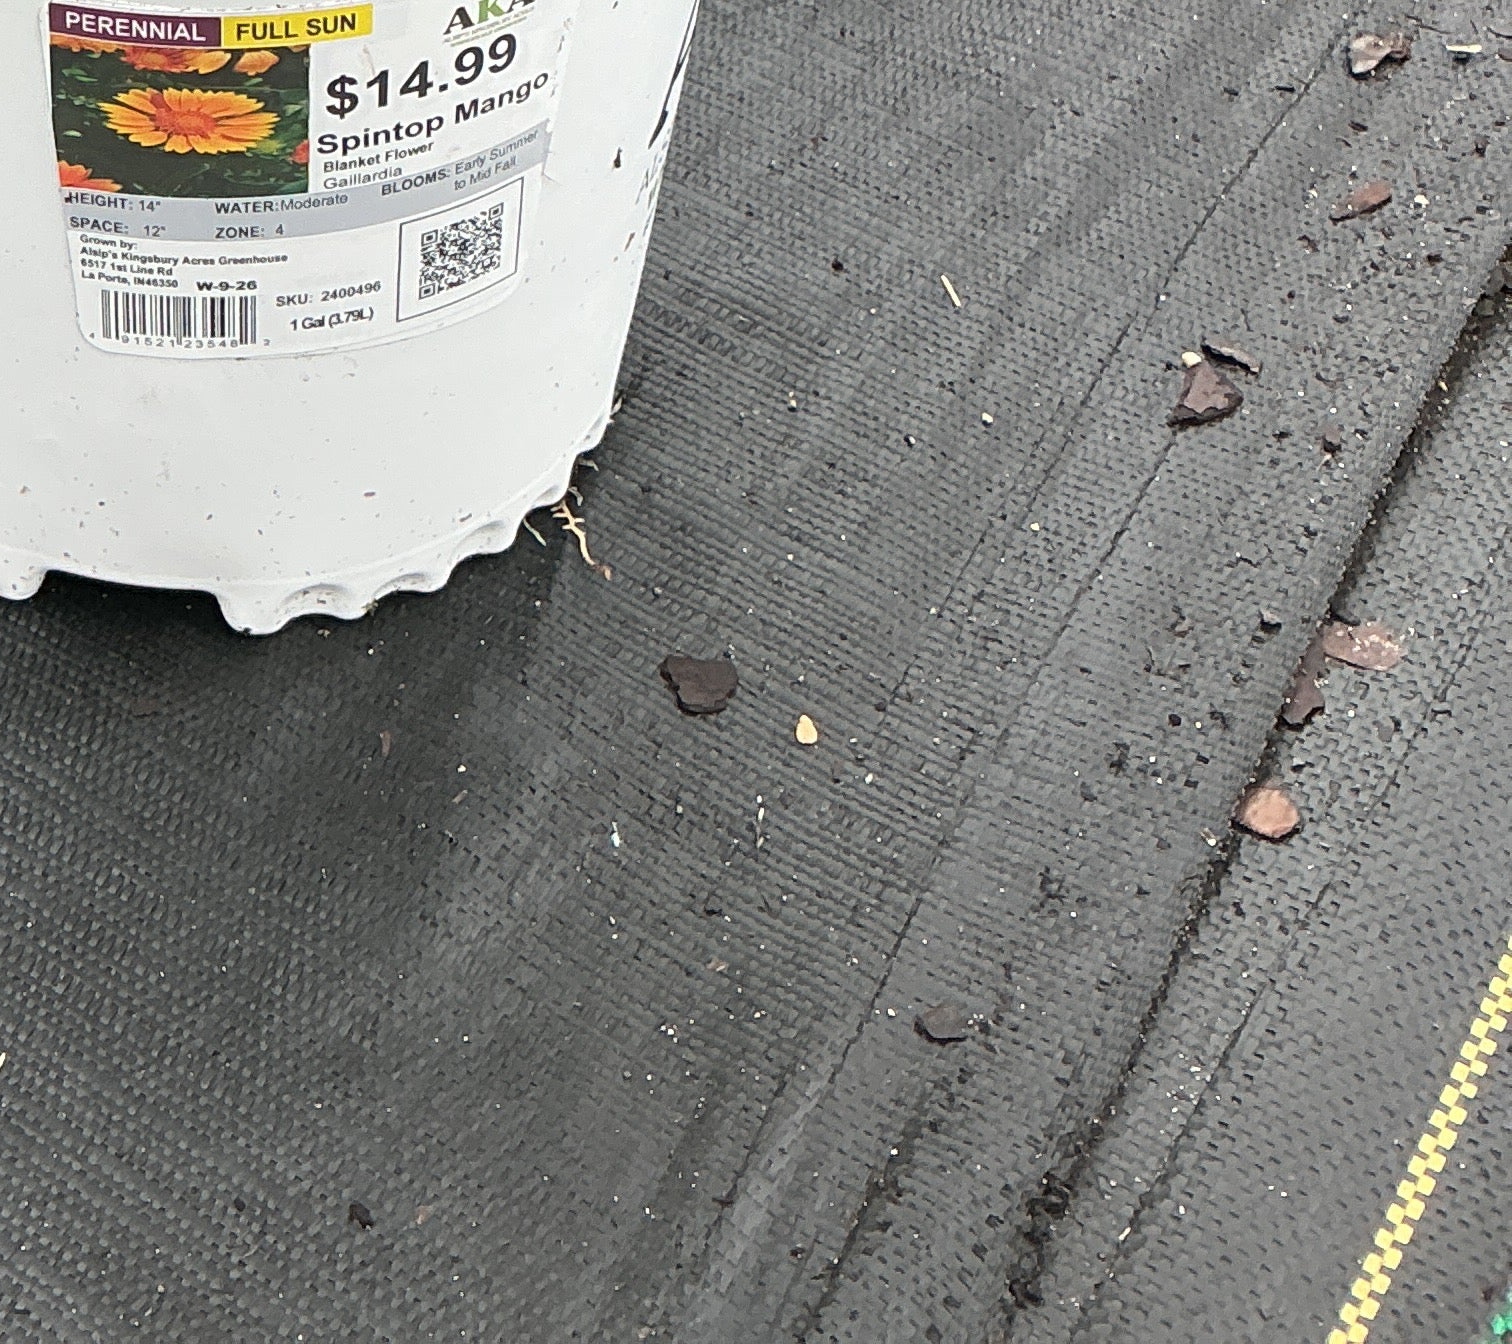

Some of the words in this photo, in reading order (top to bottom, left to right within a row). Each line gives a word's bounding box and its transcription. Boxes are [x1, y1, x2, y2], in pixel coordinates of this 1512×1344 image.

[65, 10, 207, 43] PERENNIAL
[236, 19, 299, 42] FULL
[305, 13, 357, 37] SUN
[325, 33, 518, 120] $14.99
[317, 115, 444, 156] Spintop
[454, 72, 549, 125] Mango
[323, 153, 381, 174] Blanket
[385, 140, 435, 163] Flower
[381, 168, 451, 197] BLOOMS:
[454, 154, 487, 175] Early
[489, 129, 539, 161] Summer
[323, 165, 403, 190] Gaillardia
[454, 179, 466, 191] to
[469, 168, 492, 185] Mid
[494, 155, 518, 175] Fall
[68, 192, 134, 211] HEIGHT:
[138, 199, 161, 212] 14"
[214, 200, 279, 215] WATER:
[280, 192, 349, 211] Moderate
[69, 216, 129, 234] SPACE:
[143, 224, 167, 238] 12"
[215, 226, 265, 239] ZONE:
[275, 224, 284, 235] 4
[79, 233, 117, 247] Grown
[119, 239, 138, 250] by:
[80, 246, 118, 260] Alsip's
[121, 251, 179, 267] Kingsbury
[182, 256, 215, 266] Acres
[218, 254, 288, 266] Greenhouse
[80, 257, 107, 269] 6517
[110, 262, 128, 273] 1st
[130, 264, 155, 275] Line
[157, 266, 173, 277] Rd
[81, 269, 95, 280] La
[98, 271, 131, 286] Porte,
[196, 280, 258, 292] W-9-26
[276, 293, 313, 307] SKU:
[320, 280, 382, 303] 2400496
[290, 319, 298, 331] 1
[301, 315, 326, 330] Gal
